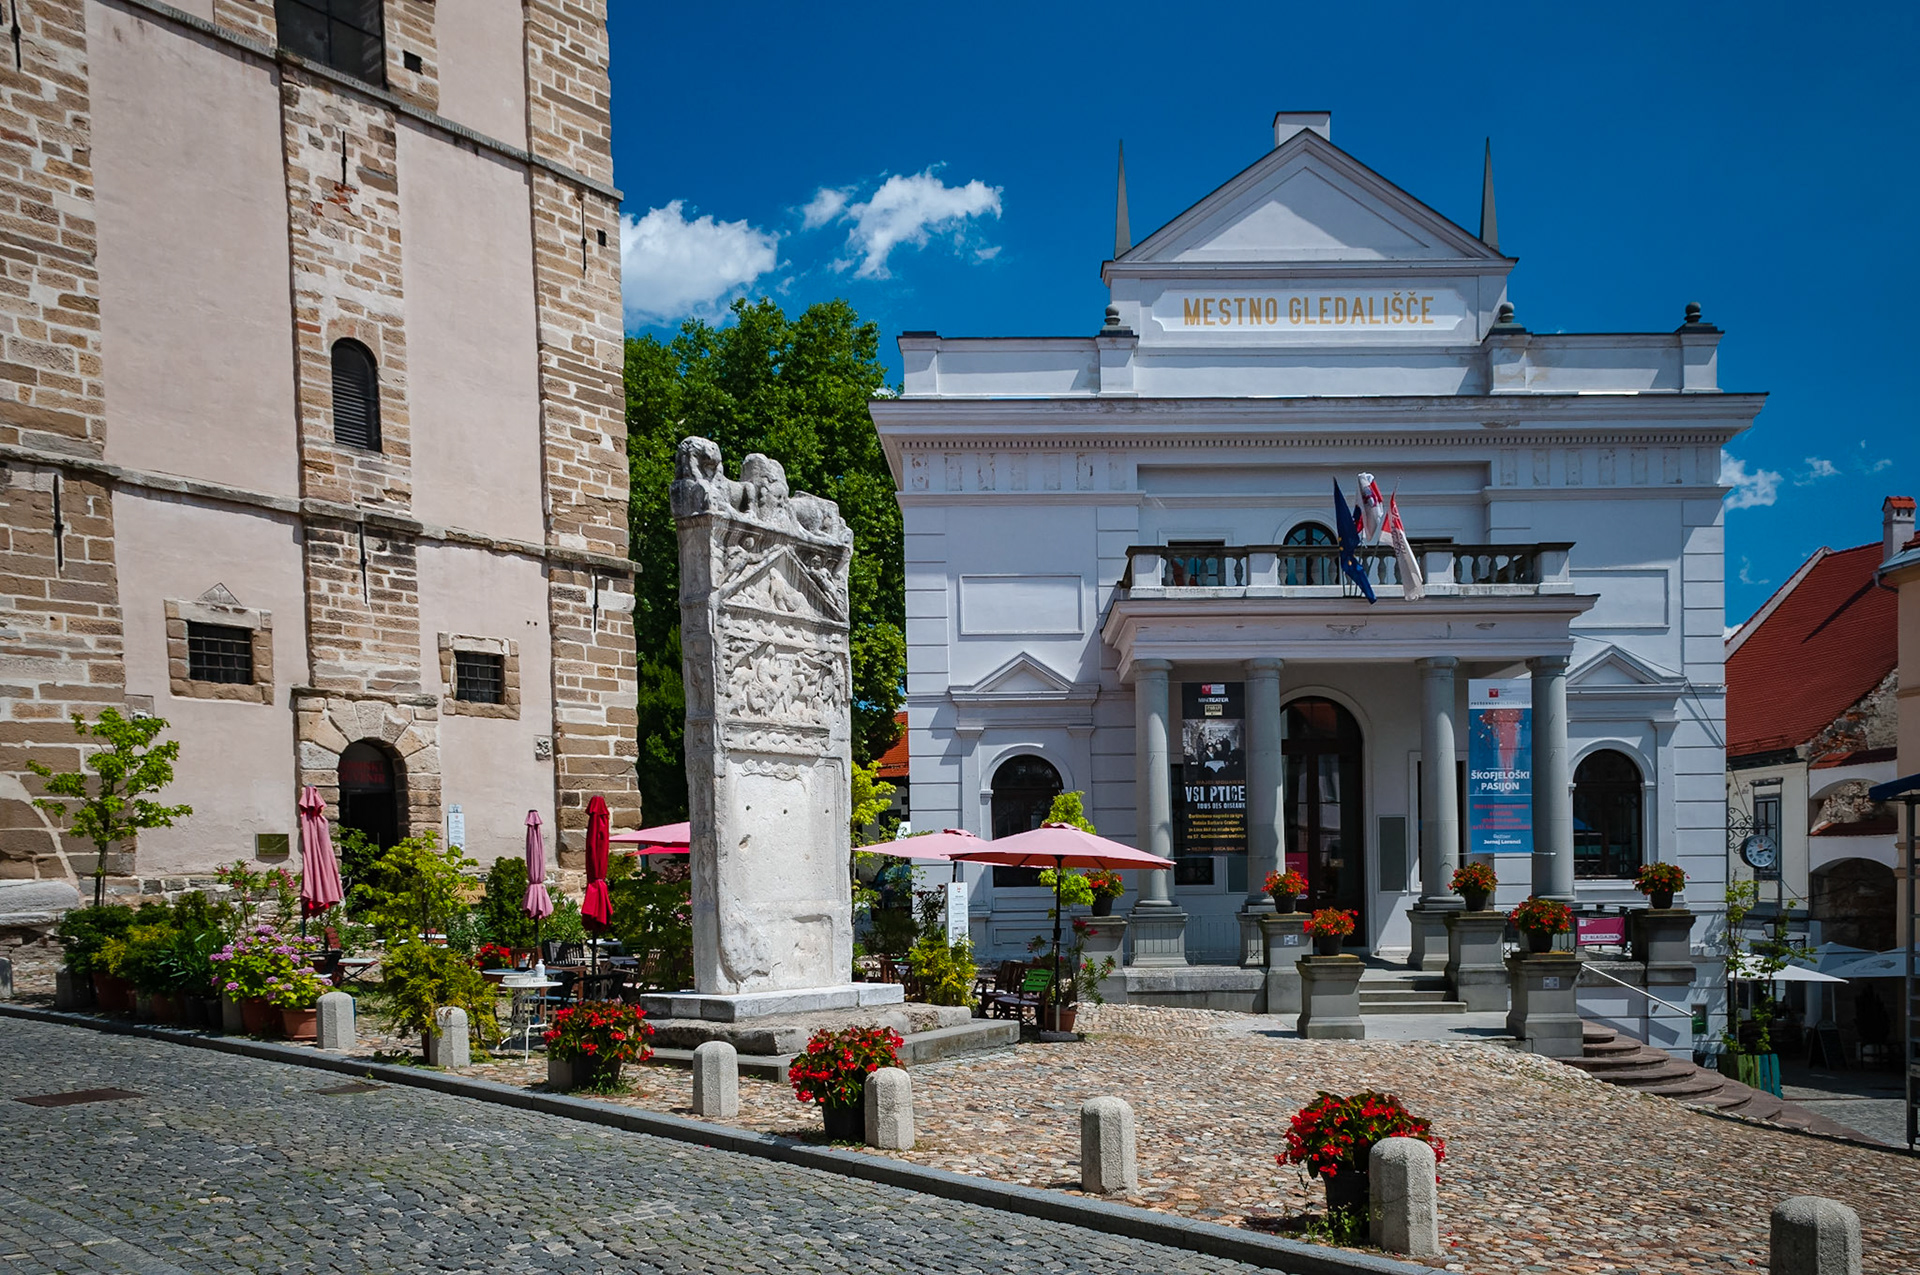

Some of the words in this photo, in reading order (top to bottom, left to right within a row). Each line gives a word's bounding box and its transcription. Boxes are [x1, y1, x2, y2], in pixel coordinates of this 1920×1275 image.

[1184, 297, 1278, 326] MESTNO
[1288, 291, 1434, 325] GLEDALIŠČE
[1471, 769, 1530, 781] ŠKOFJELOŠKI
[1185, 786, 1205, 802] VSI
[1210, 786, 1246, 802] PTICE
[1481, 782, 1520, 792] PASIJON
